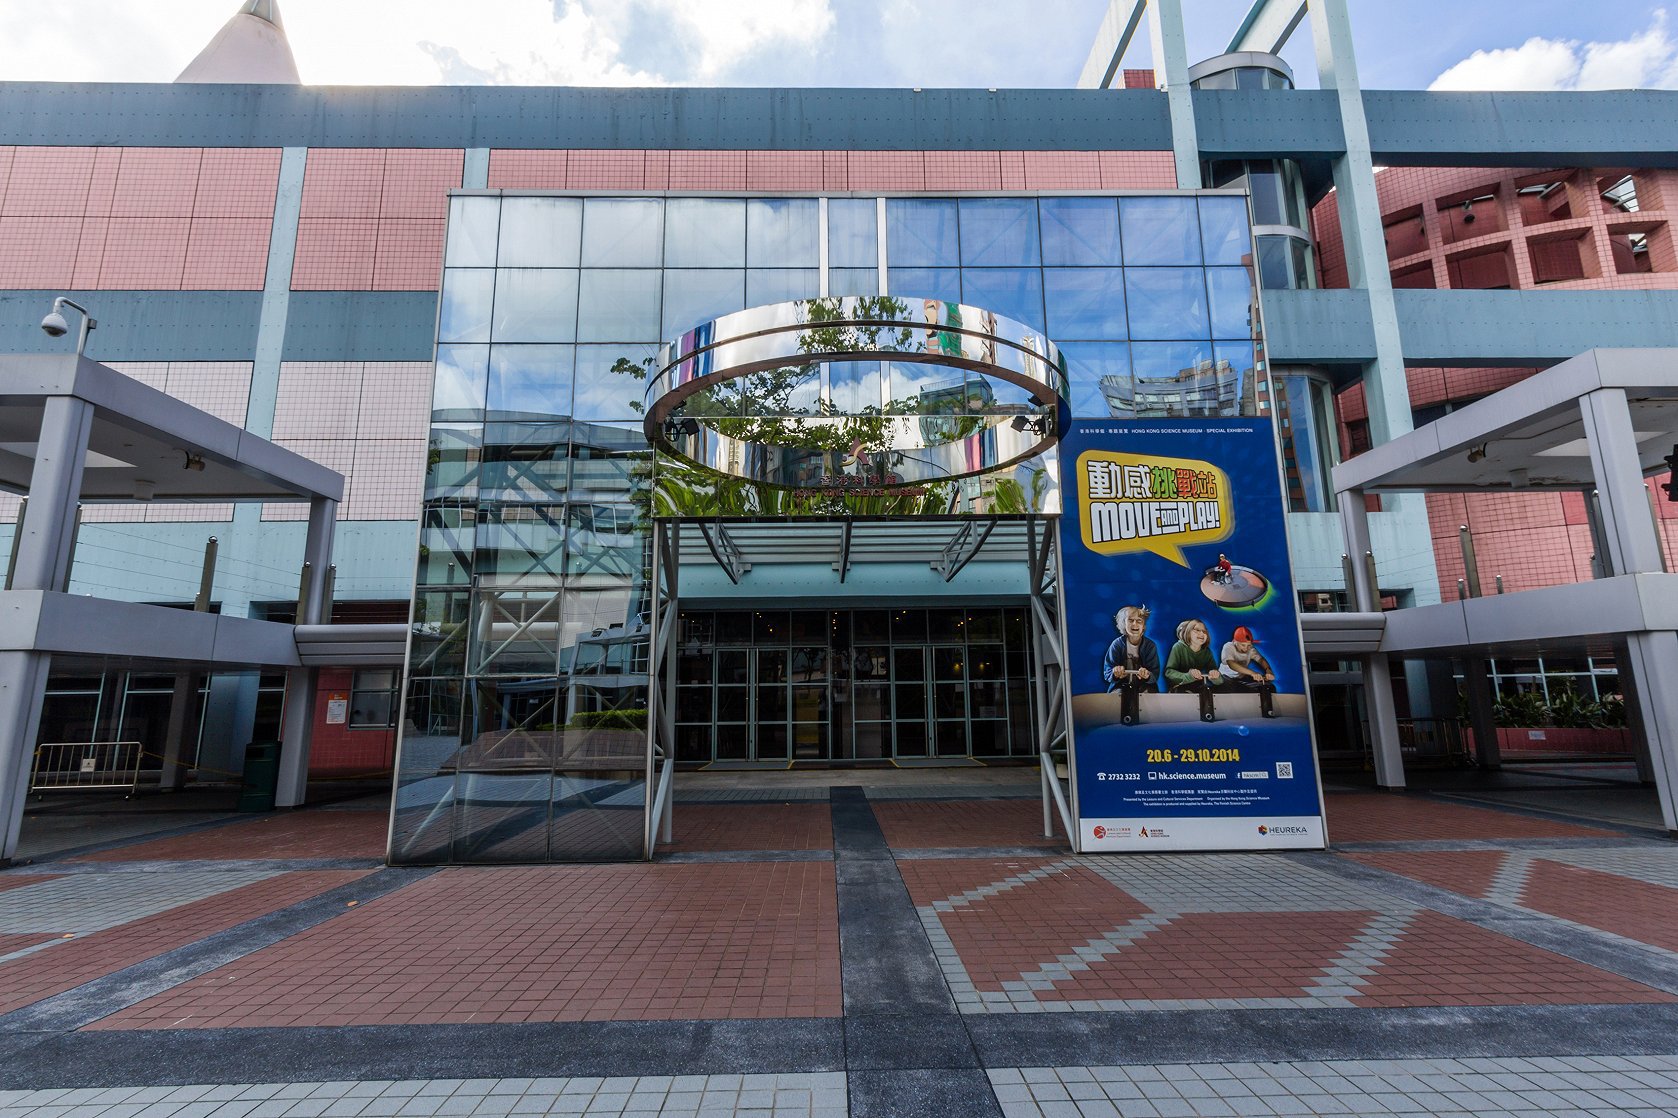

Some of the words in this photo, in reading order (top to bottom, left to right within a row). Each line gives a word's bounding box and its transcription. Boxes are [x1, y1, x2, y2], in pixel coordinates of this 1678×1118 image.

[1087, 460, 1218, 499] 動感挑戰站
[793, 488, 817, 498] HONG
[821, 488, 845, 498] KONG
[848, 488, 885, 498] SCIENCE
[888, 487, 927, 497] MUSEUM
[1090, 501, 1163, 544] MOVE
[1177, 501, 1221, 533] PLAY!
[1146, 749, 1173, 763] 20.6
[1180, 748, 1240, 762] 29.10.2014
[1158, 771, 1227, 780] hk.science.museum
[1269, 826, 1308, 834] HEUREKA
